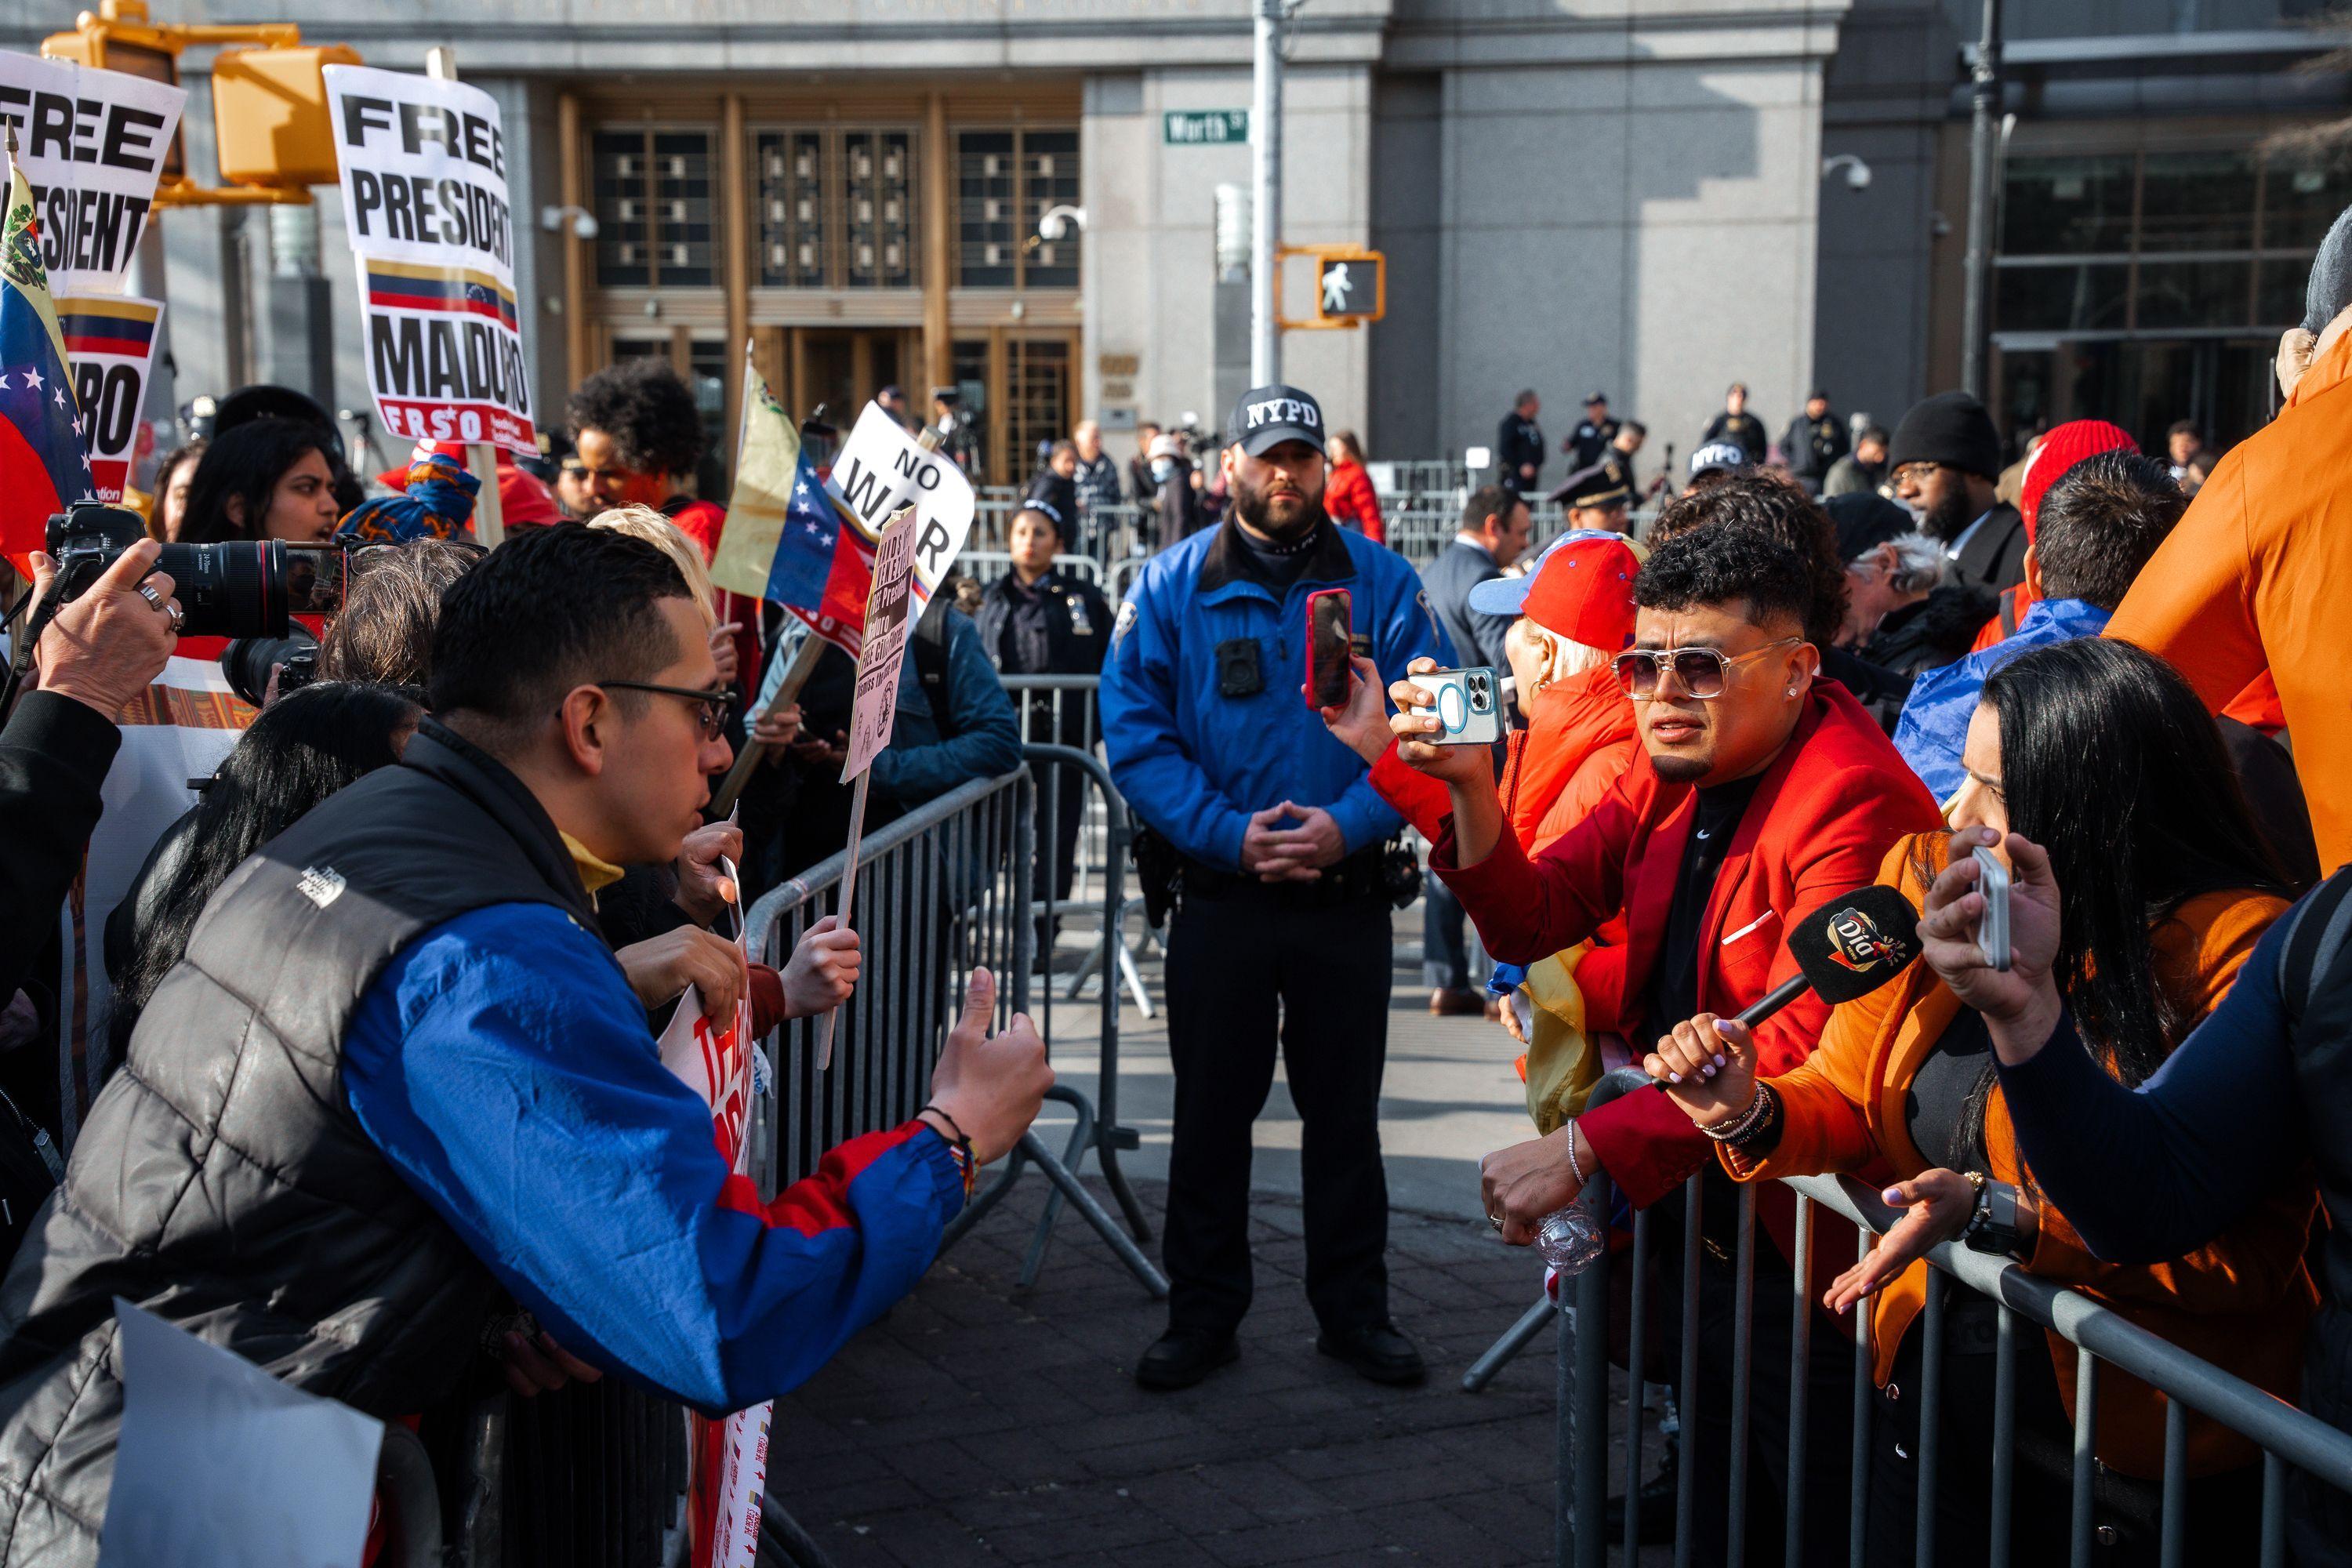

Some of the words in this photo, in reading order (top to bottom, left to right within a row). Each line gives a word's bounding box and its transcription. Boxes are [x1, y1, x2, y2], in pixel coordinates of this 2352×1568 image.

[341, 93, 505, 181] FREE
[372, 314, 527, 415] MADURO
[383, 405, 482, 441] FRSO
[1247, 398, 1317, 428] NYPD
[894, 448, 941, 491] NO
[1837, 920, 1875, 956] Día
